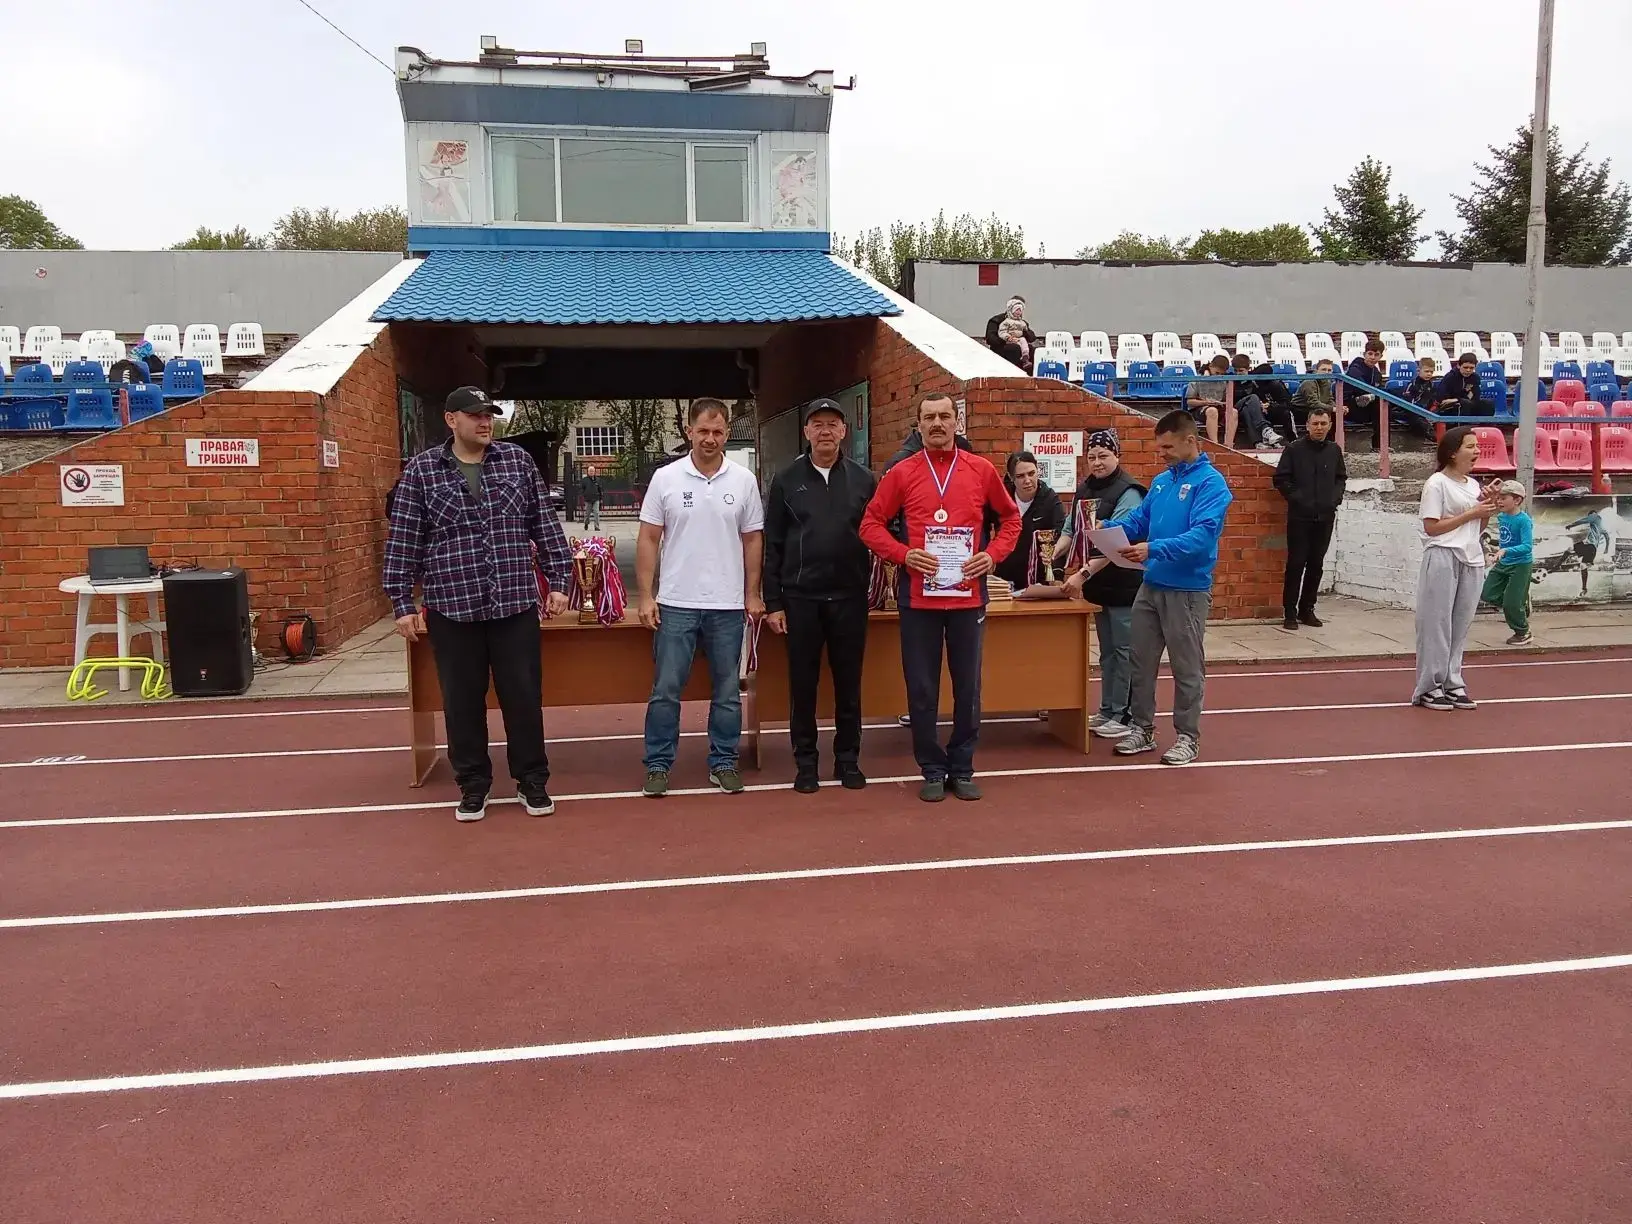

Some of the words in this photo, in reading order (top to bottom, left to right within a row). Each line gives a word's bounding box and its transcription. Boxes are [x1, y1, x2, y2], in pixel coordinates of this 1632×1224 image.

[1039, 433, 1069, 443] ЛЕВАЯ
[200, 441, 244, 451] ПРАВАЯ
[1033, 445, 1074, 455] ТРИБУНА
[198, 454, 248, 464] ТРИБУНА
